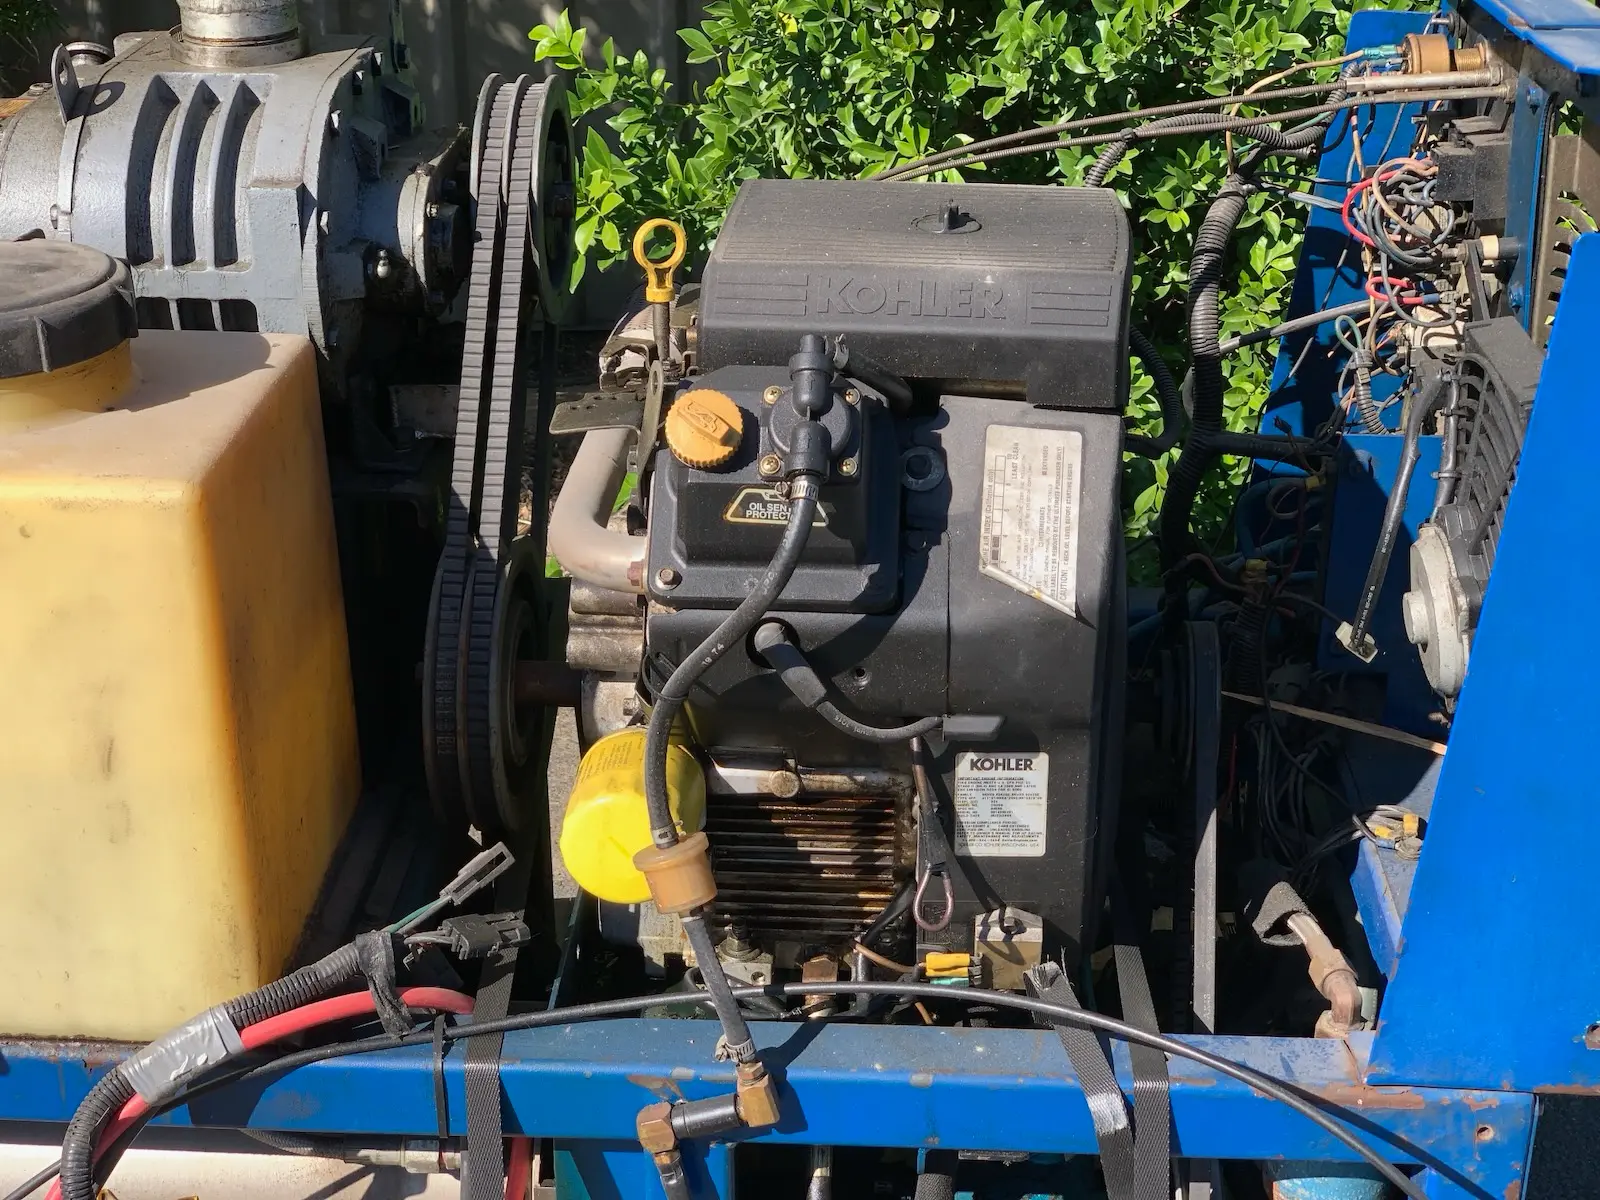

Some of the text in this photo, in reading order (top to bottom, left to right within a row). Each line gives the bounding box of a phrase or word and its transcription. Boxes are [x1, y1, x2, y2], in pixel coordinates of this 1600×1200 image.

[817, 277, 1006, 320] KOHLER
[749, 502, 766, 511] OIL
[1060, 570, 1068, 600] CAUTION!
[970, 758, 1034, 771] KOHLER
